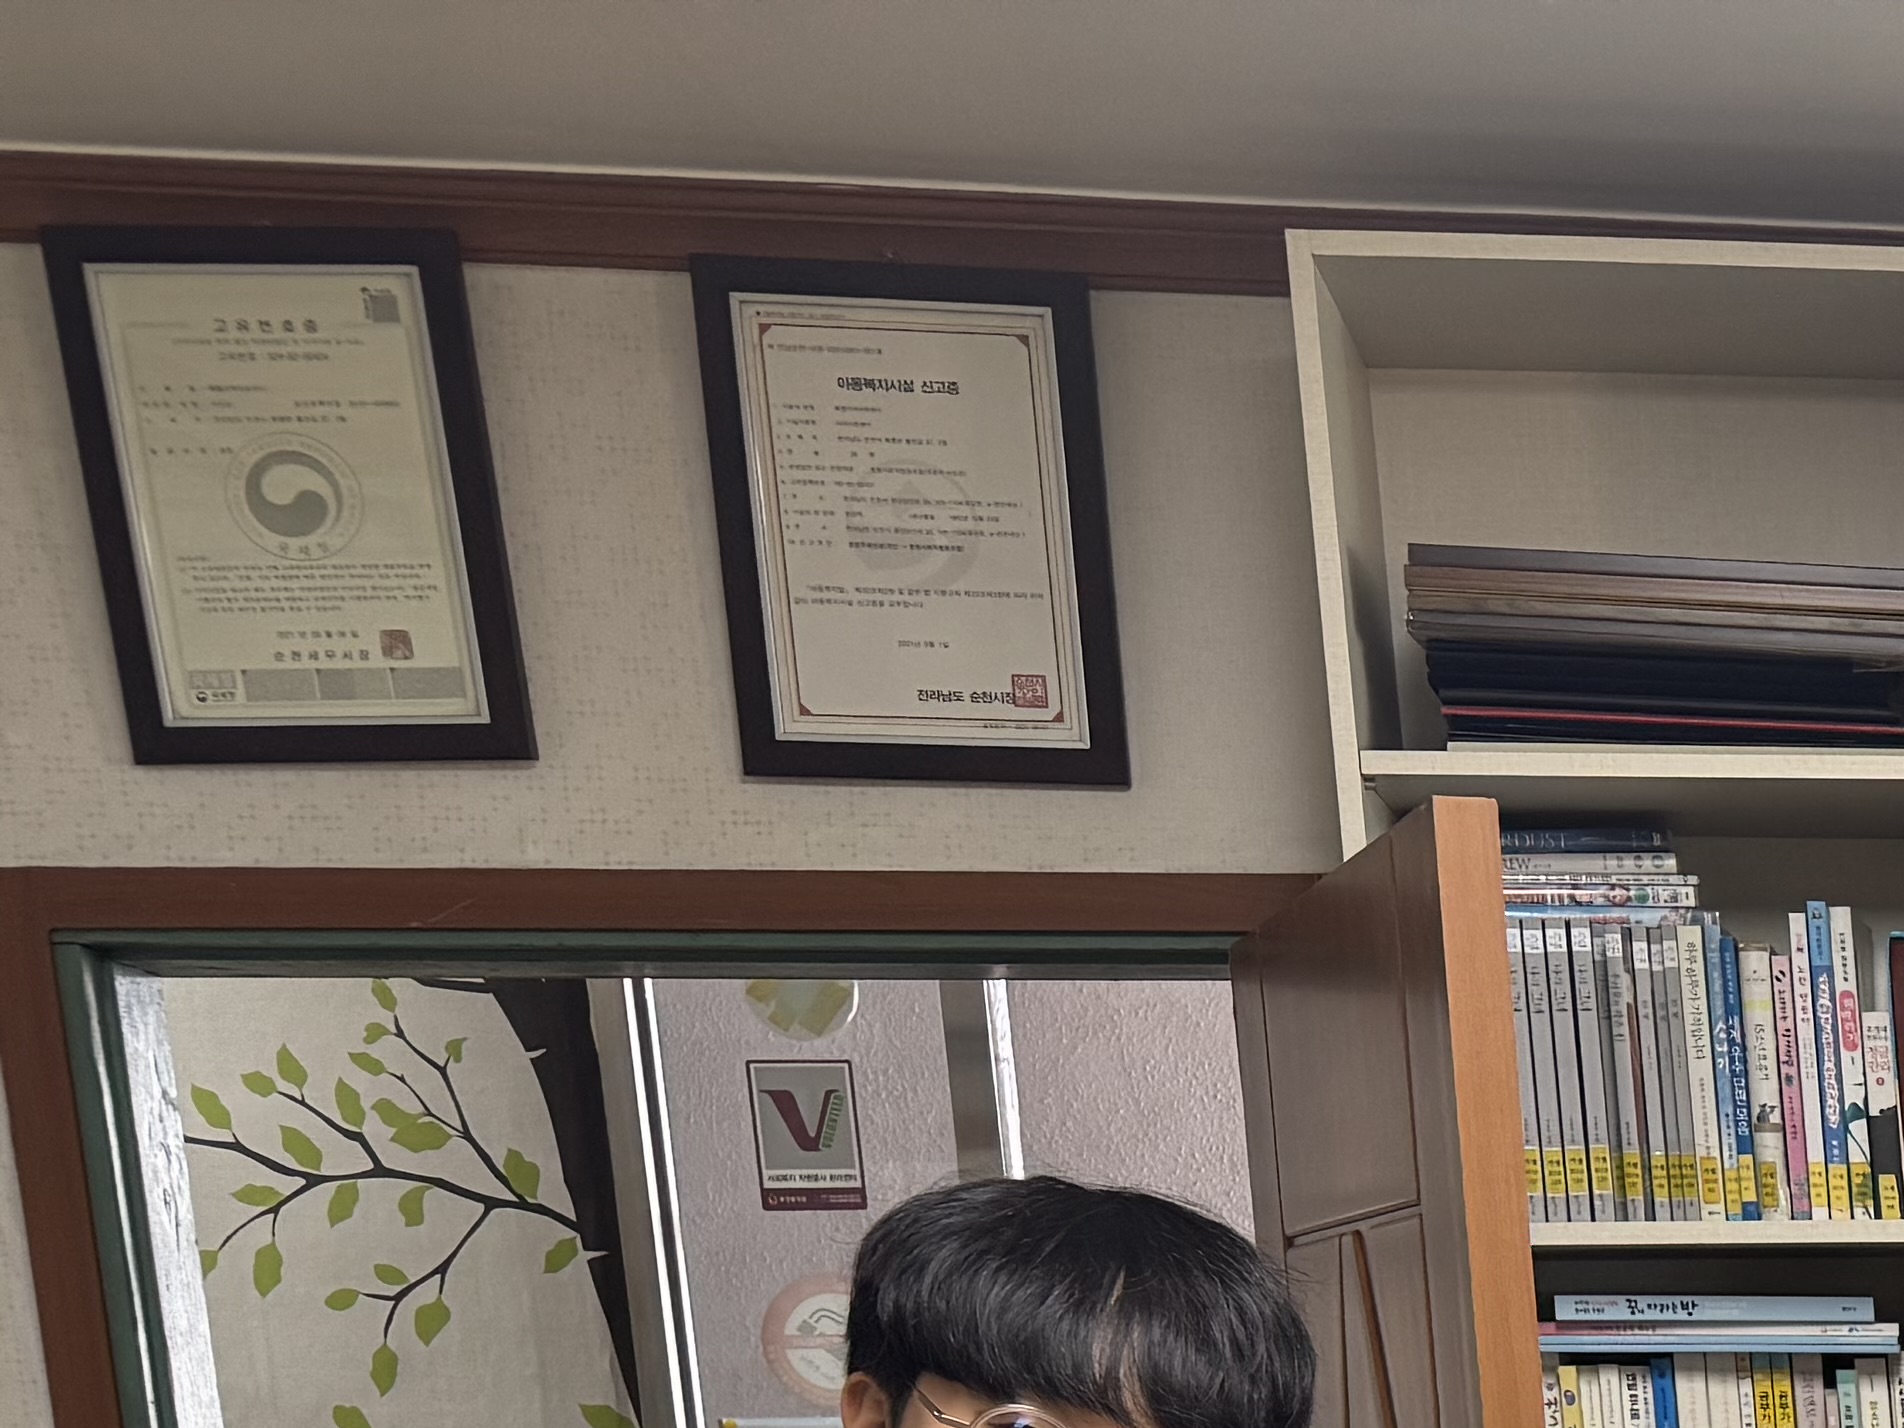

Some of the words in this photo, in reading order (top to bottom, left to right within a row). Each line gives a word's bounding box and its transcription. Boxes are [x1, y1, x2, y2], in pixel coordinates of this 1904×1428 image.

[917, 689, 966, 703] 전라남도
[969, 690, 1016, 705] 순천시장
[1689, 1005, 1706, 1061] 기적입니다
